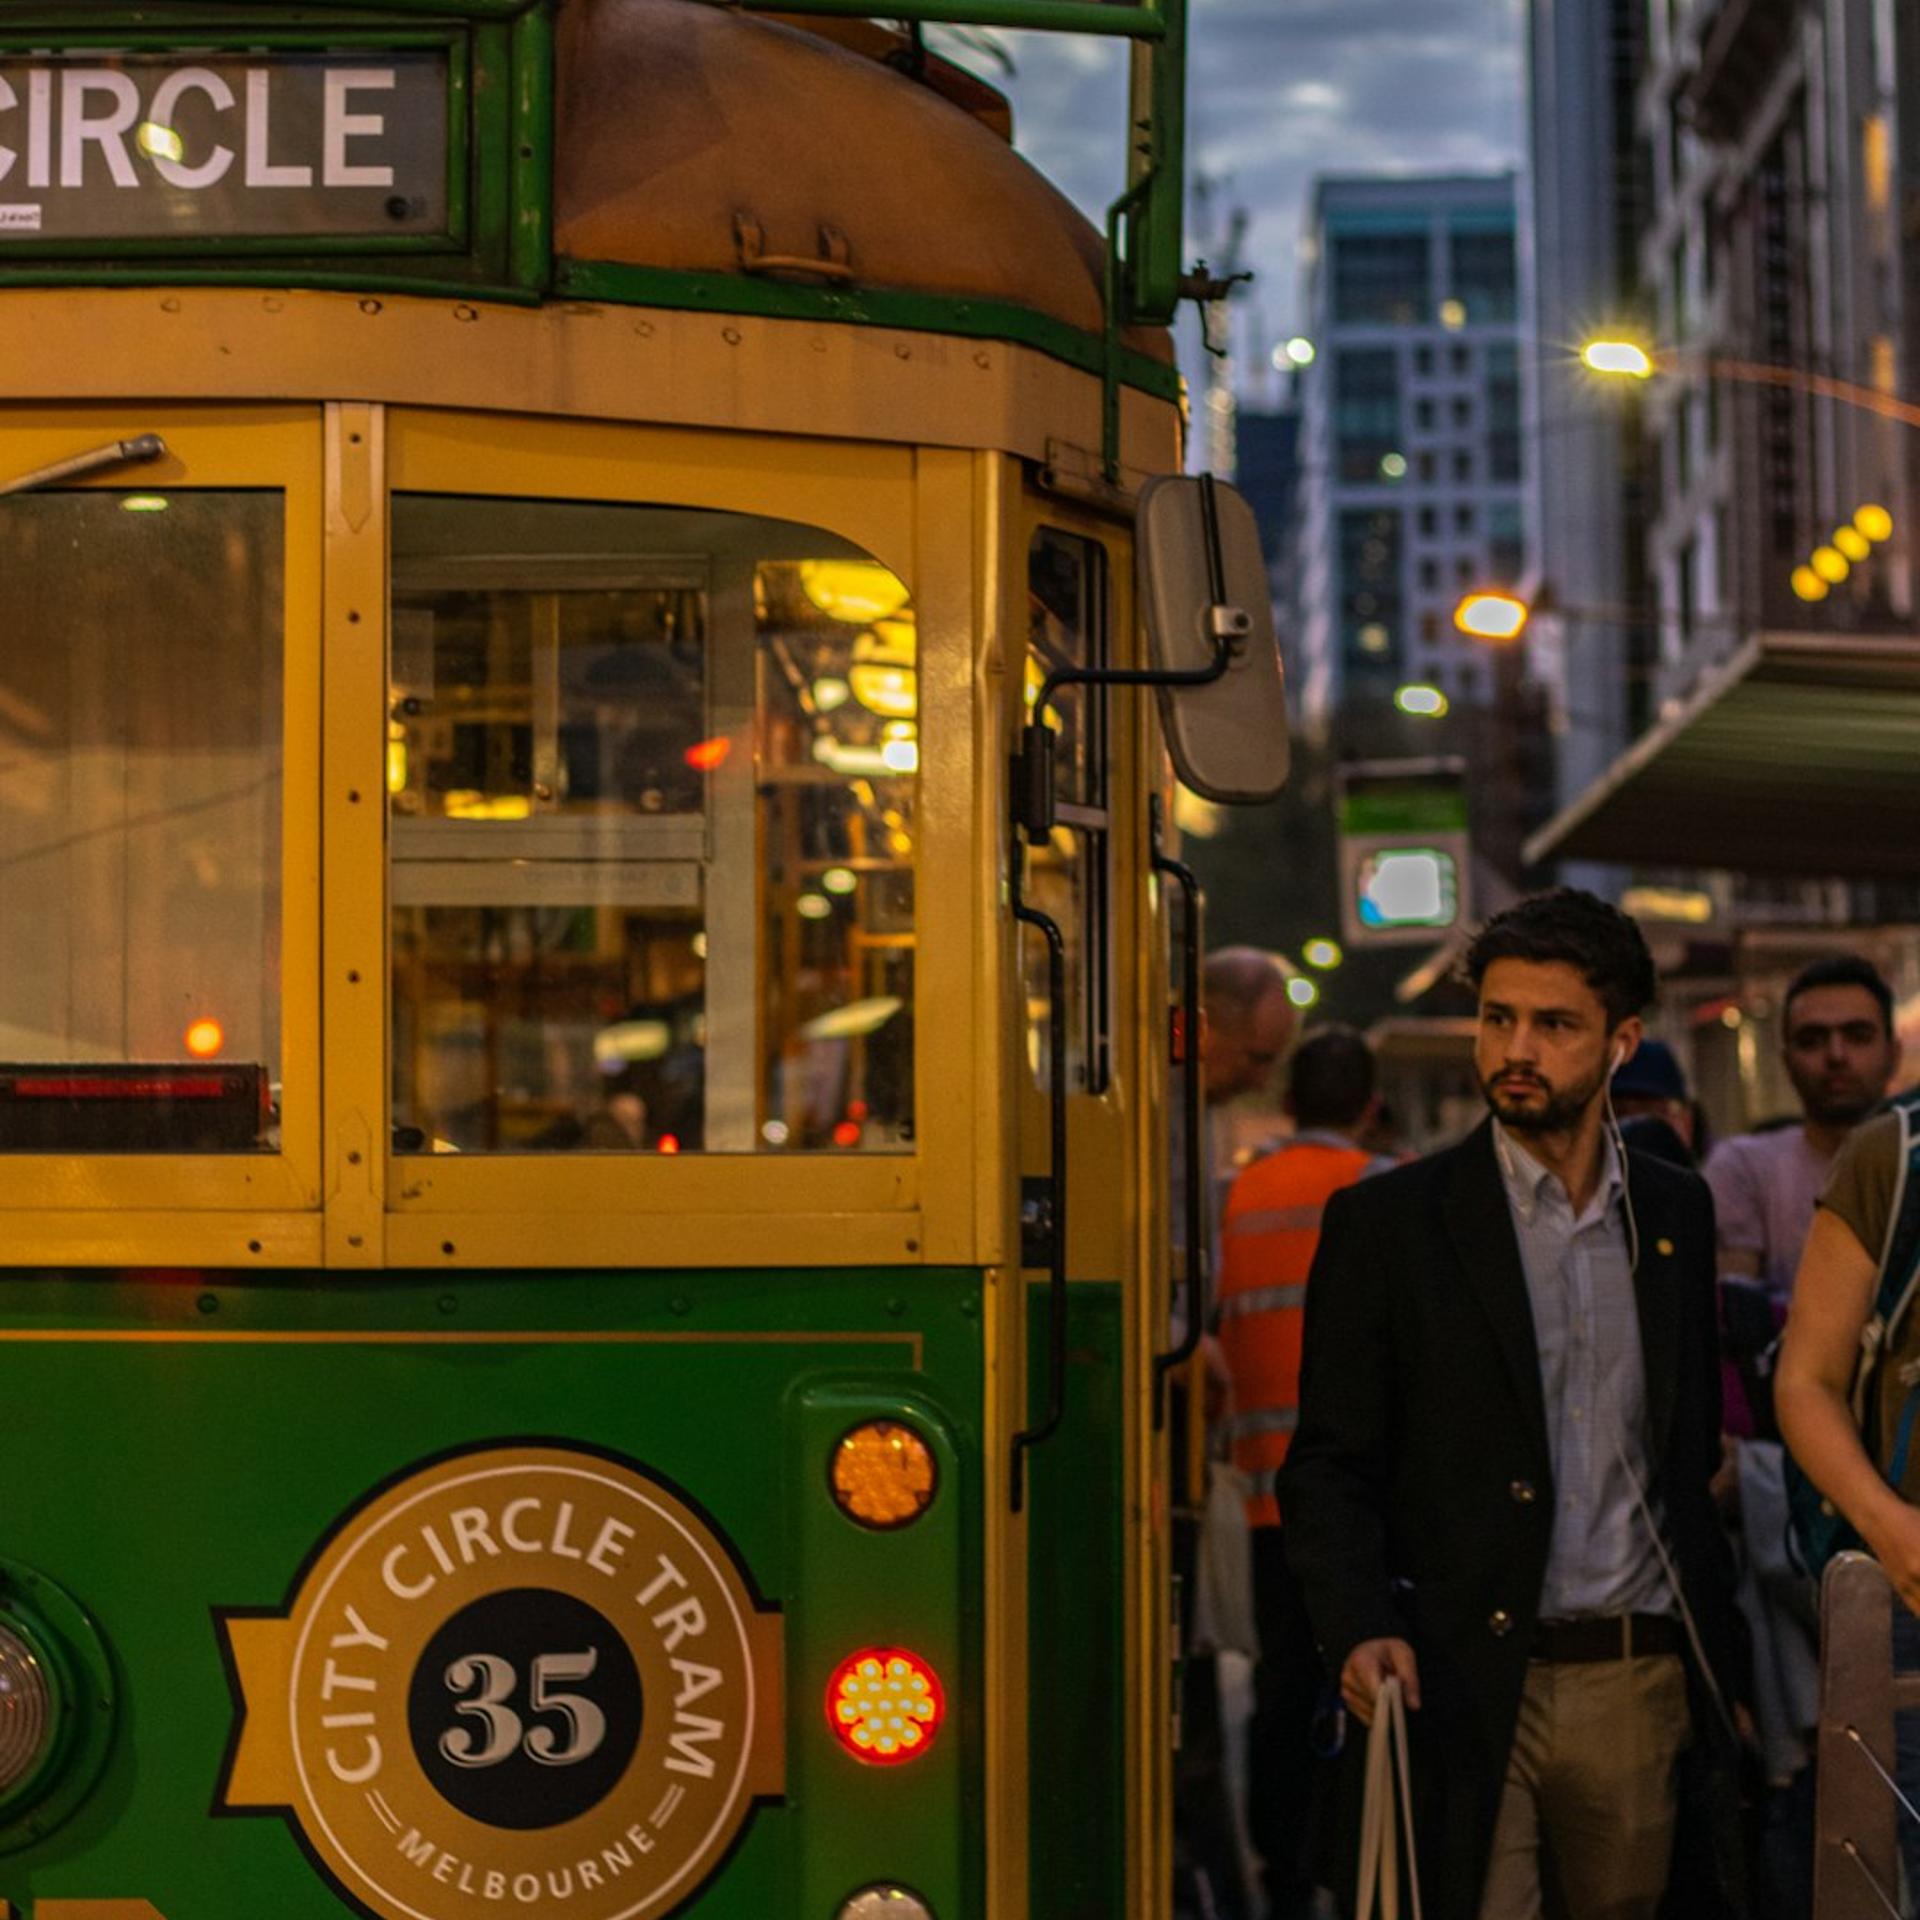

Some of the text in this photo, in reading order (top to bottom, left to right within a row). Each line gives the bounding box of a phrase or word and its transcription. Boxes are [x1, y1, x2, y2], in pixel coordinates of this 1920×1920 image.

[0, 67, 396, 189] IRCLE
[321, 1498, 725, 1785] CITY CIRCLE TRAM
[438, 1645, 607, 1769] 35
[396, 1823, 655, 1902] MELBOURNE
